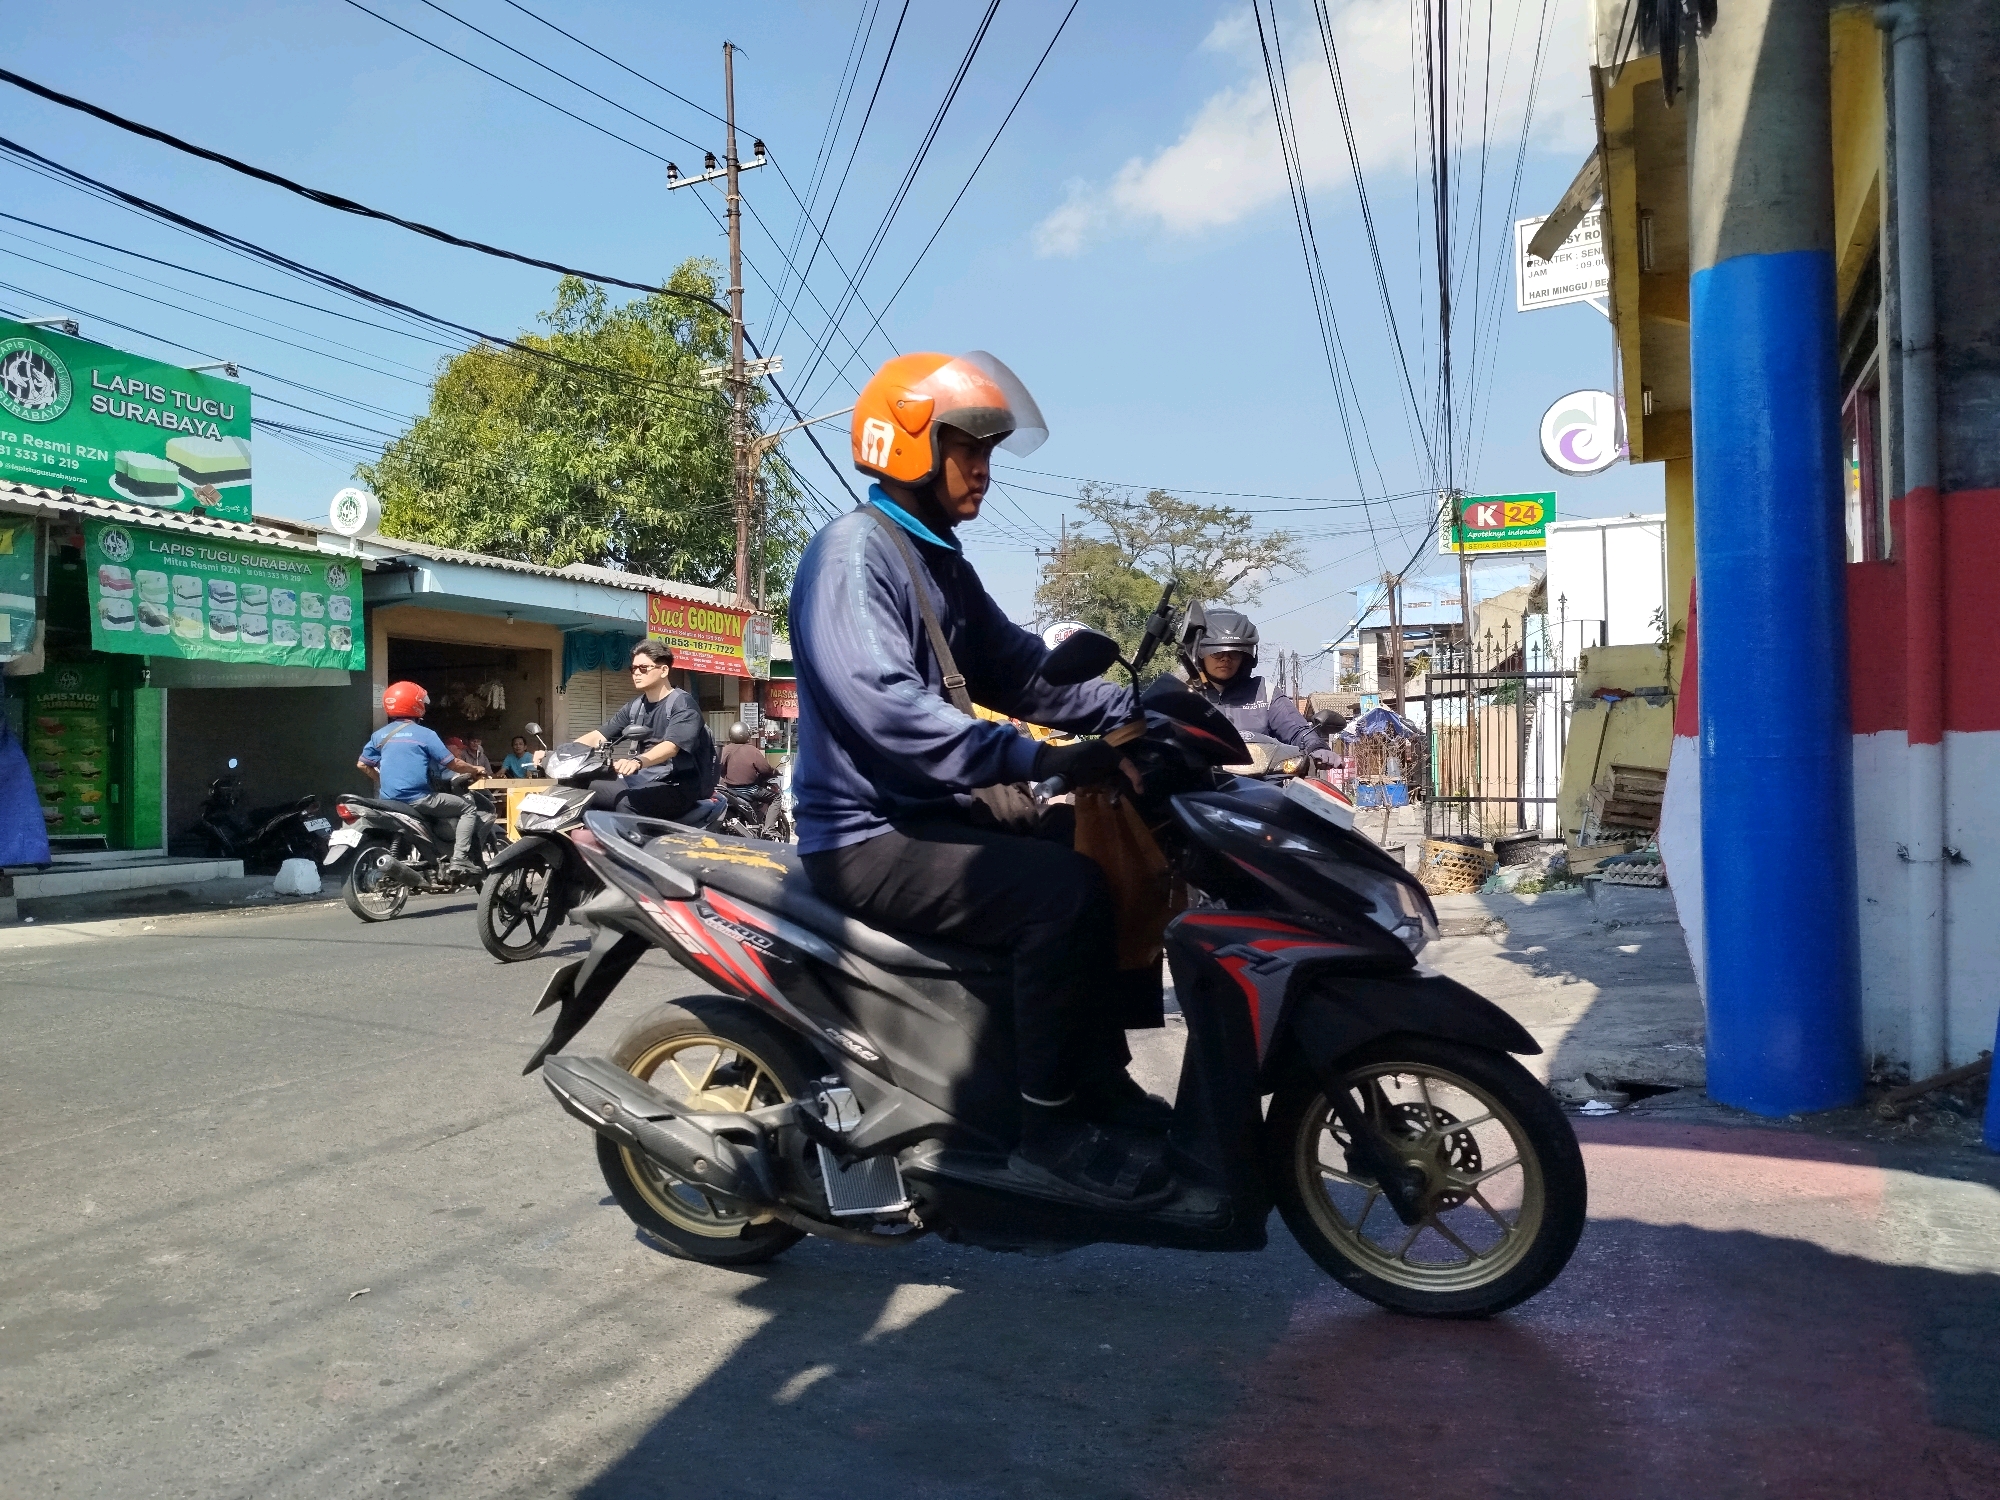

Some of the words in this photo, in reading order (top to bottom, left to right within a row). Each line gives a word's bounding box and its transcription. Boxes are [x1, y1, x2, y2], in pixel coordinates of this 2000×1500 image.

[1528, 269, 1548, 278] JAM
[1529, 287, 1550, 299] HARI
[1552, 281, 1588, 295] MINGGU
[39, 346, 65, 374] TUGU
[92, 369, 167, 403] LAPIS
[170, 389, 235, 421] TUGU
[91, 394, 223, 441] SURABAYA
[23, 433, 71, 455] Resmi
[76, 444, 109, 462] RZN
[15, 448, 38, 462] 333
[42, 453, 55, 465] 16
[59, 457, 79, 470] 219
[1477, 504, 1499, 527] K
[1508, 505, 1537, 523] 24
[1467, 530, 1506, 539] Apoteknya
[1468, 542, 1491, 550] SEDIA
[150, 540, 195, 557] LAPIS
[198, 547, 238, 564] TUGU
[241, 554, 312, 575] SURABAYA
[163, 556, 189, 568] Mitra
[190, 560, 219, 572] Resmi
[221, 564, 241, 575] RZN
[267, 571, 280, 579] 333
[649, 597, 687, 629] Suci
[687, 606, 741, 638] GORDYN
[664, 636, 735, 655] 0853-1877-7722
